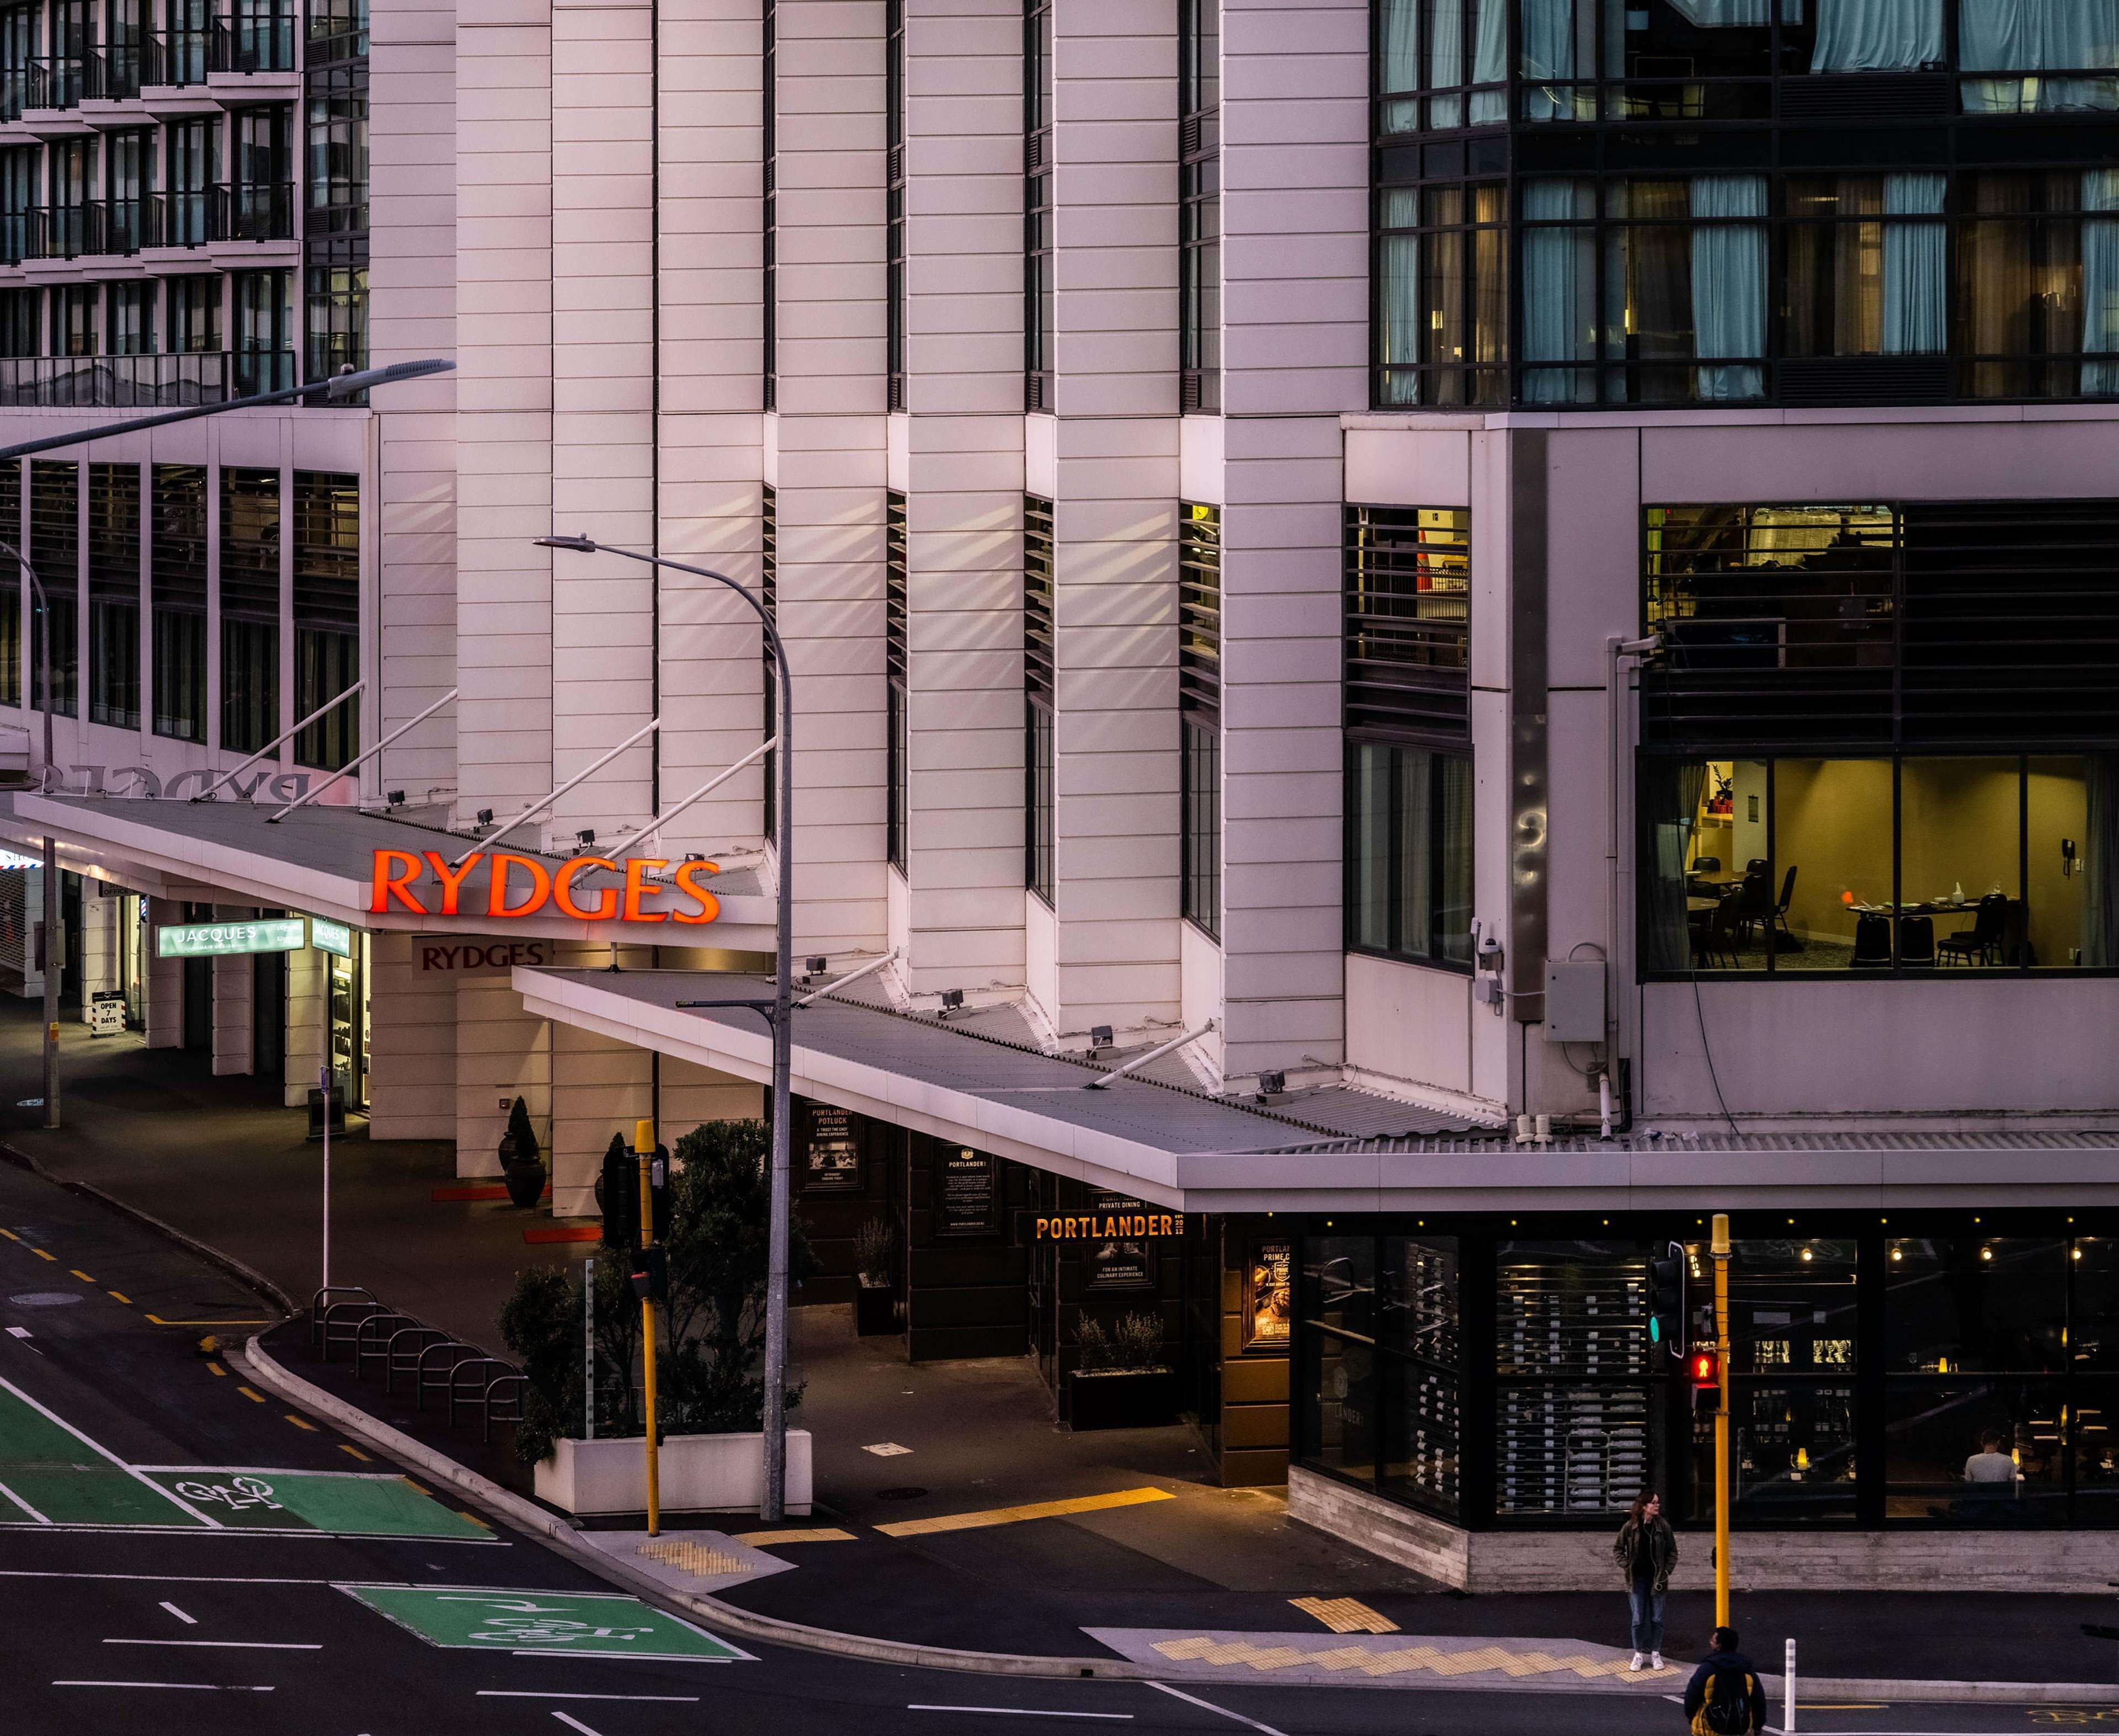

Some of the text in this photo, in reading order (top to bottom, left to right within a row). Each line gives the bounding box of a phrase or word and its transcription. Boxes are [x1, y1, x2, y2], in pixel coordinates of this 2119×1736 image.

[369, 849, 720, 924] RYDGES
[178, 926, 258, 943] JACQUES
[314, 923, 339, 940] JACQUES
[422, 943, 544, 970] RYDGES
[1037, 1215, 1172, 1238] PORTLANDER
